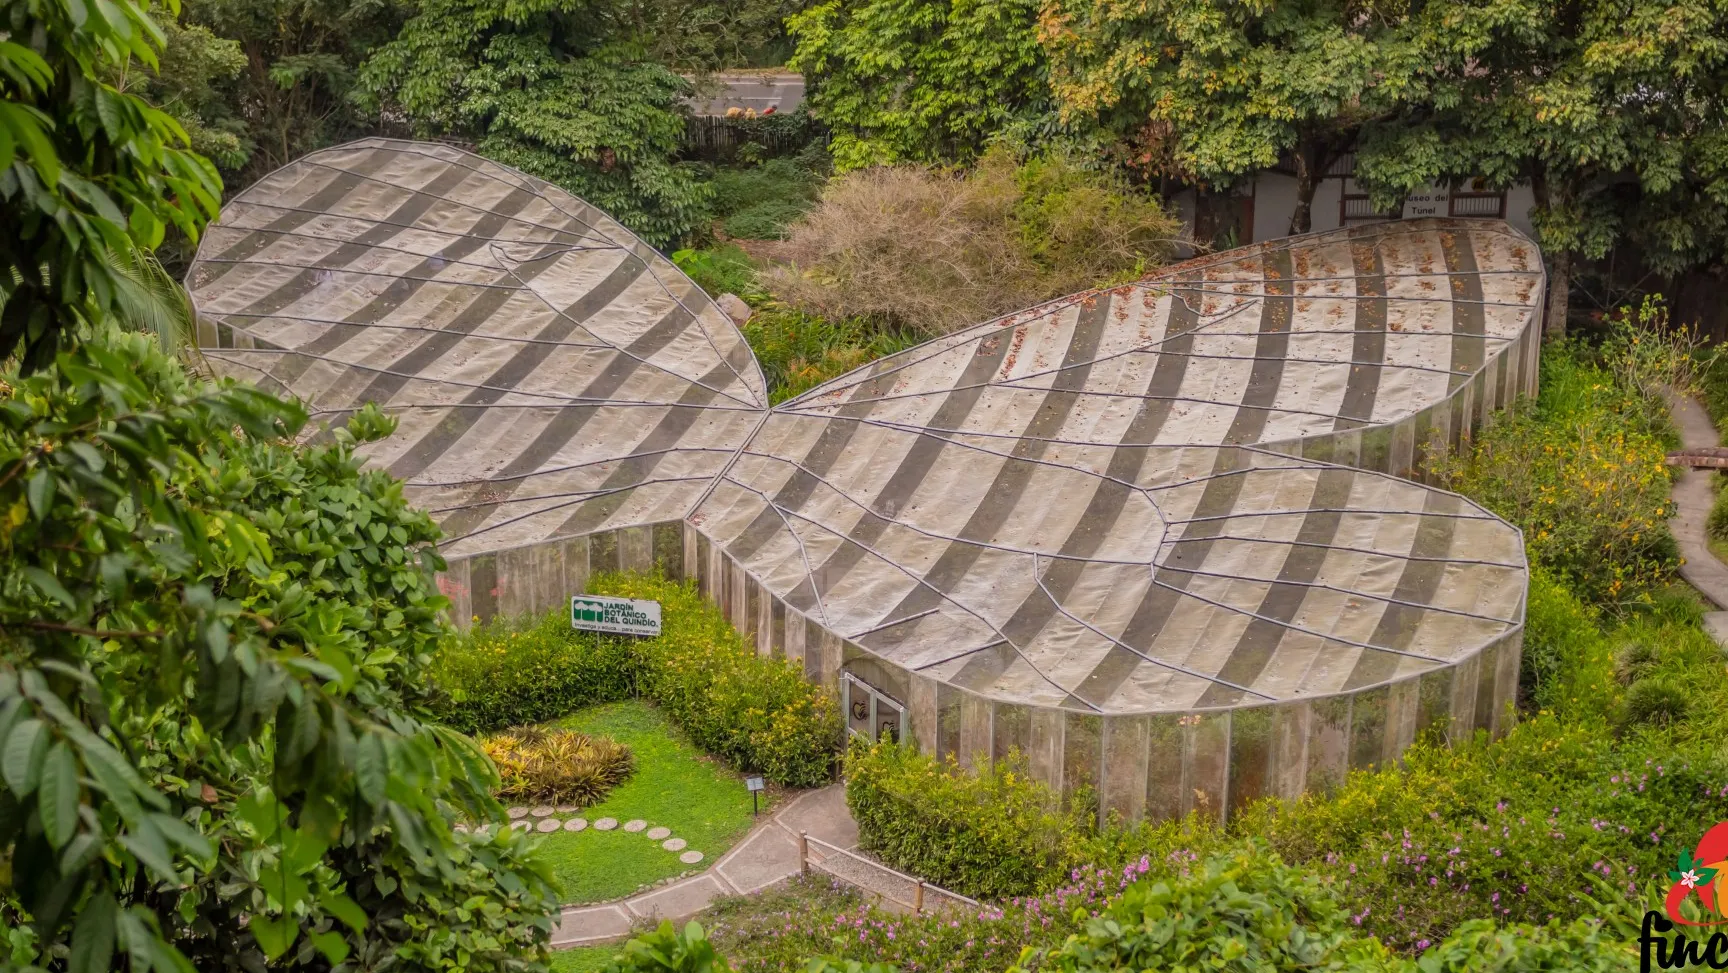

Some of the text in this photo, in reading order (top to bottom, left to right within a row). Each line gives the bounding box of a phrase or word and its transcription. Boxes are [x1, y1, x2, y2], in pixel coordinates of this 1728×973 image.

[1434, 194, 1449, 202] del
[604, 602, 634, 611] JARDÍN
[604, 616, 620, 624] DEL
